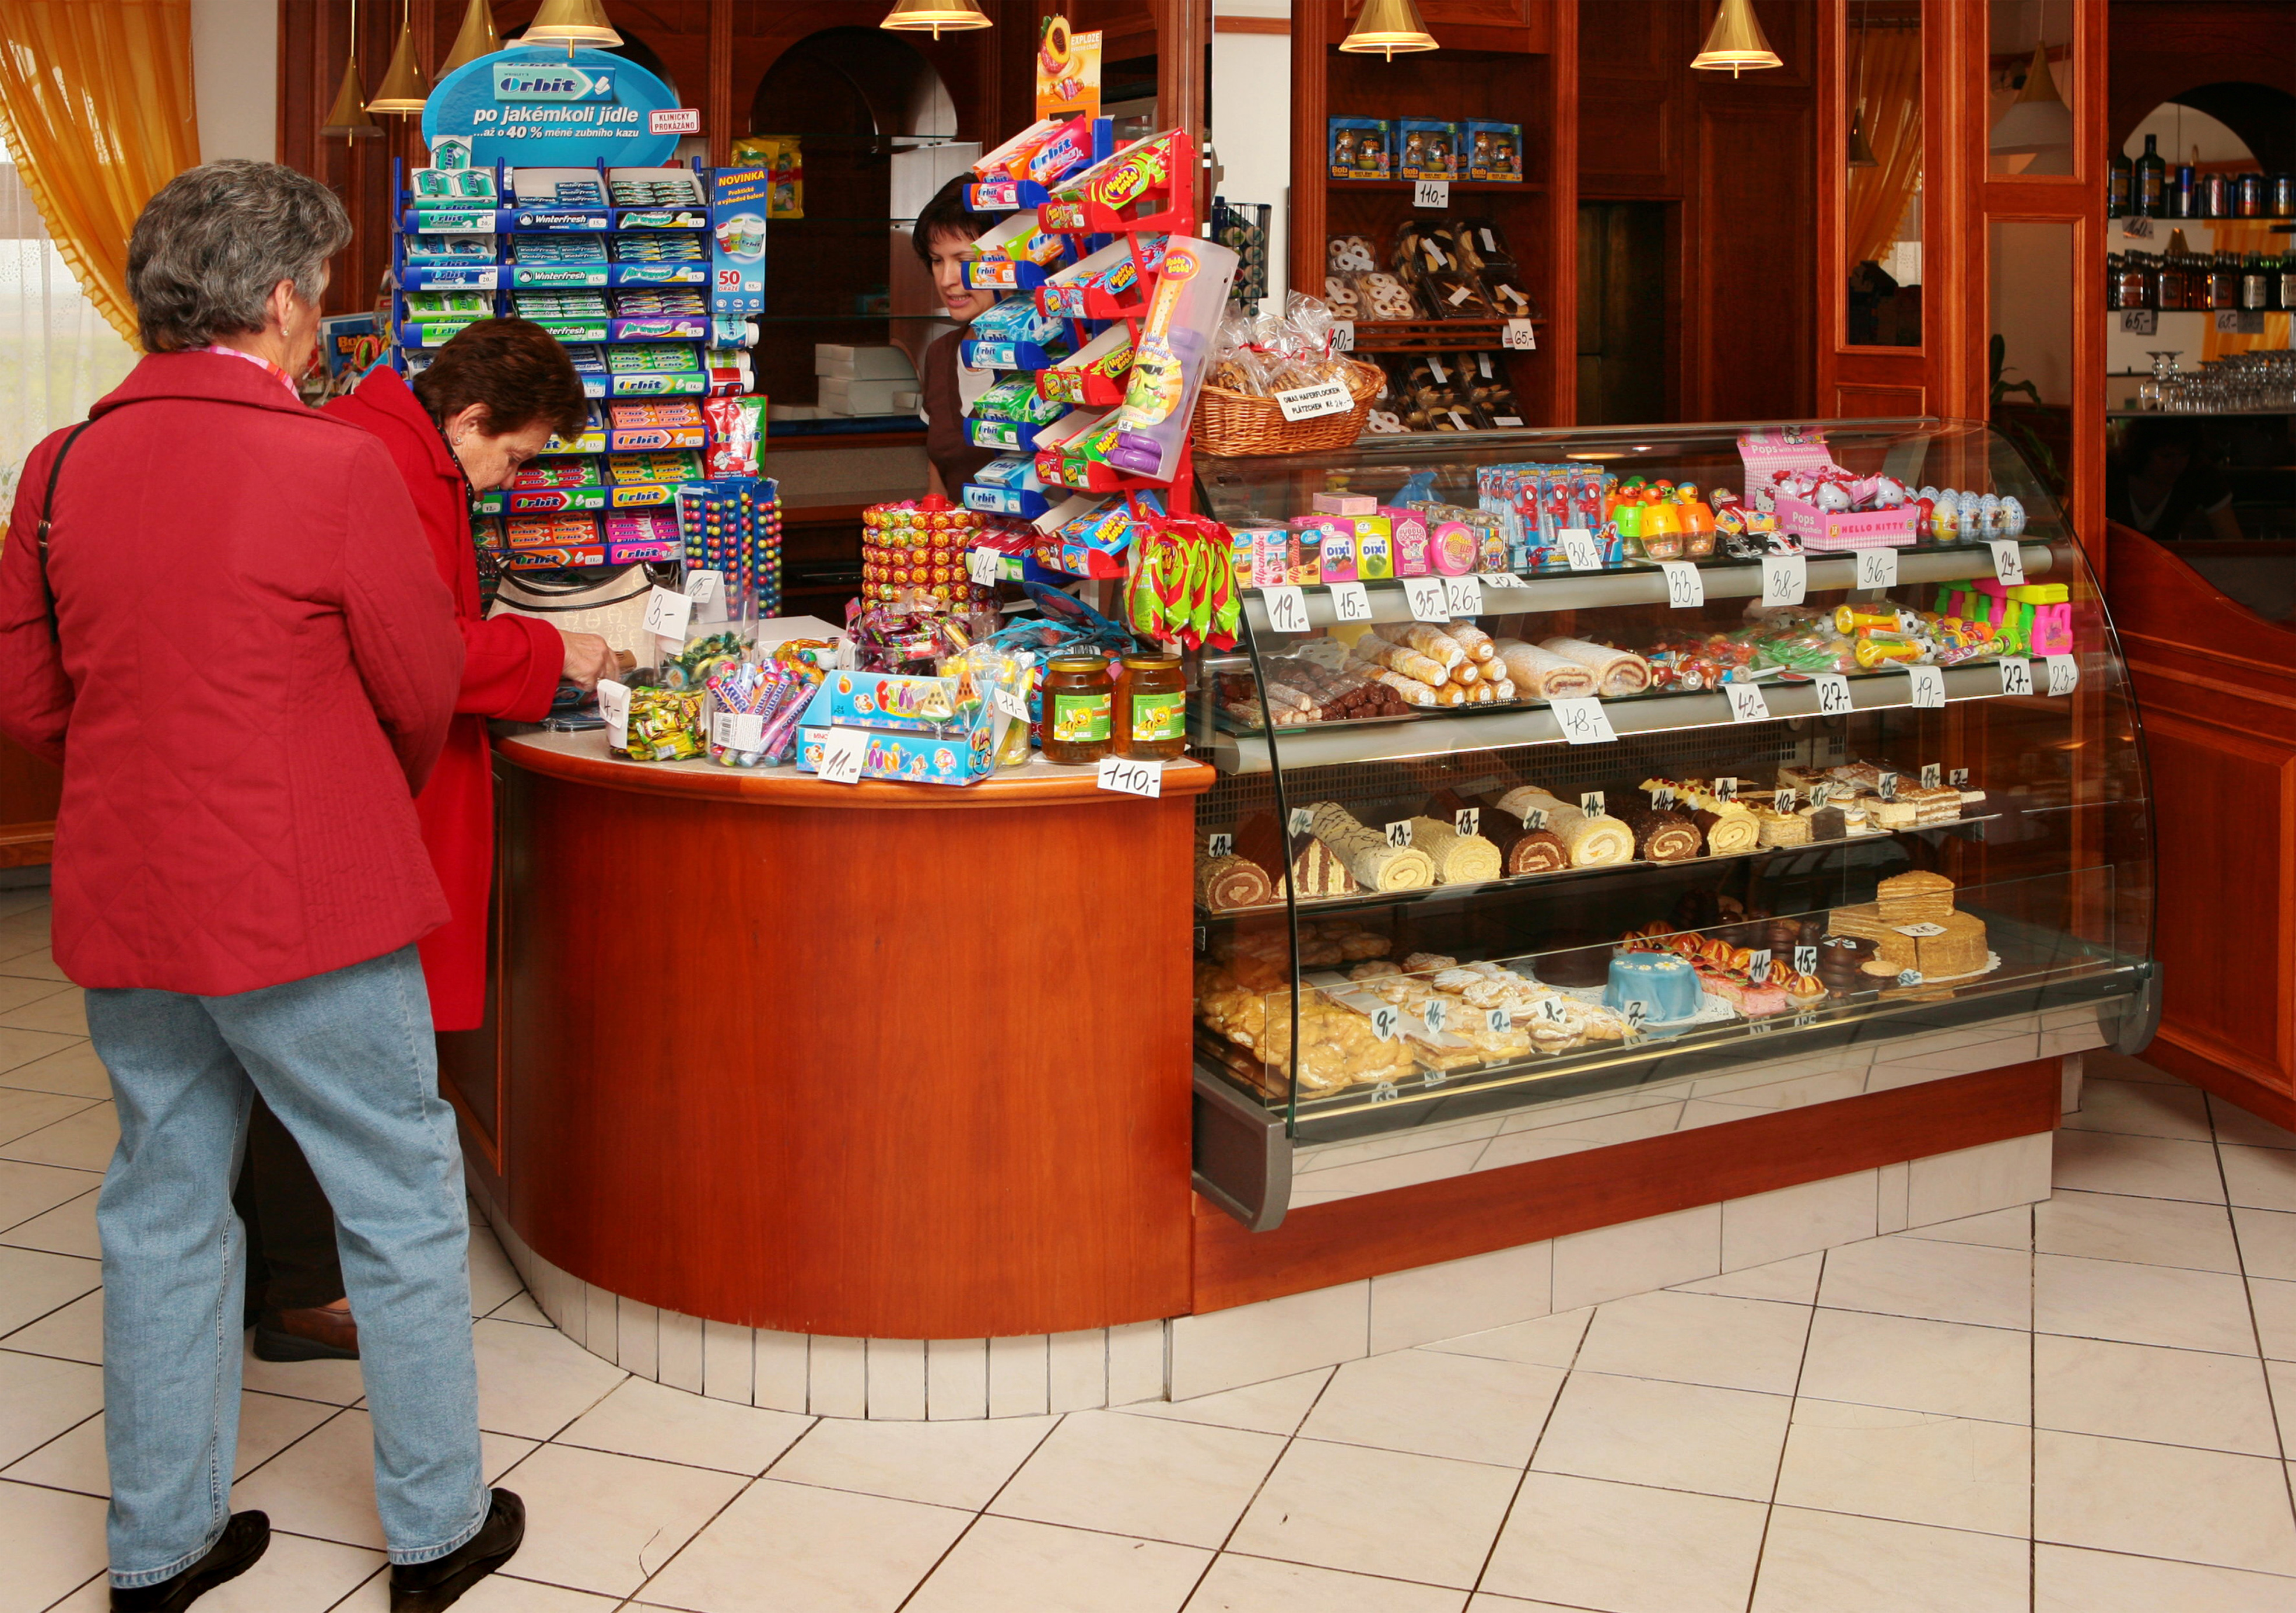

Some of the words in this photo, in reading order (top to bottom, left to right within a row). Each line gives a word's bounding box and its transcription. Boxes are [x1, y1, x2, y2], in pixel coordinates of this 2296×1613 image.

[1071, 32, 1100, 45] EXPLOZE
[499, 76, 577, 94] Orbit
[473, 107, 498, 125] po
[500, 105, 595, 125] jakémkoli
[597, 106, 640, 125] jídle
[658, 112, 690, 121] KLINICKY
[497, 129, 504, 138] o
[506, 125, 527, 139] 40
[530, 126, 544, 139] %
[544, 127, 573, 138] méně
[574, 127, 613, 138] zubního
[615, 128, 640, 138] kazu
[654, 120, 695, 131] PROKÁZÁNO
[1030, 138, 1072, 171] Orbit
[1332, 166, 1348, 174] Bob
[718, 170, 765, 187] NOVINKA
[1106, 170, 1129, 193] Hubba
[1116, 171, 1138, 195] Bubba
[728, 186, 755, 197] Praktické
[1420, 184, 1446, 205] 110,-
[429, 214, 464, 222] Orbit
[535, 215, 587, 224] Winterfresh
[1166, 258, 1185, 267] Hubba
[1168, 264, 1190, 273] Bubba
[431, 270, 467, 279] Orbit
[534, 272, 587, 280] Winterfresh
[718, 271, 741, 285] 50
[976, 267, 996, 275] Orbit
[1110, 265, 1128, 286] Hubba
[1118, 265, 1135, 287] Bubba
[546, 326, 586, 335] nterfresh
[1515, 331, 1533, 347] 65,-
[619, 380, 662, 390] Orbit
[618, 435, 661, 445] Orbit
[1752, 444, 1778, 456] Pops
[516, 497, 562, 508] Orbit
[617, 491, 661, 502] Orbit
[971, 492, 996, 503] Orbit
[1793, 512, 1815, 525] Pops
[1841, 524, 1872, 534] HELLO
[1876, 523, 1904, 531] KITTY
[616, 548, 660, 559] Orbit
[1254, 534, 1267, 585] Alpenliebe
[1288, 534, 1301, 583] Alpenliebe
[1568, 542, 1596, 567] 38,-
[975, 554, 994, 583] 21,-
[1864, 556, 1894, 584] 36,-
[1670, 570, 1700, 605] 33,-
[1772, 570, 1801, 599] 38,-
[1341, 591, 1365, 618] 15,-
[1450, 585, 1481, 612] 26,-
[647, 594, 675, 630] 3,-
[1273, 594, 1305, 629] 19,-
[753, 682, 774, 715] mento
[1916, 676, 1941, 707] 19,-
[1002, 695, 1022, 715] 11,-
[1566, 707, 1603, 738] 48,-
[1103, 763, 1159, 795] 110,-
